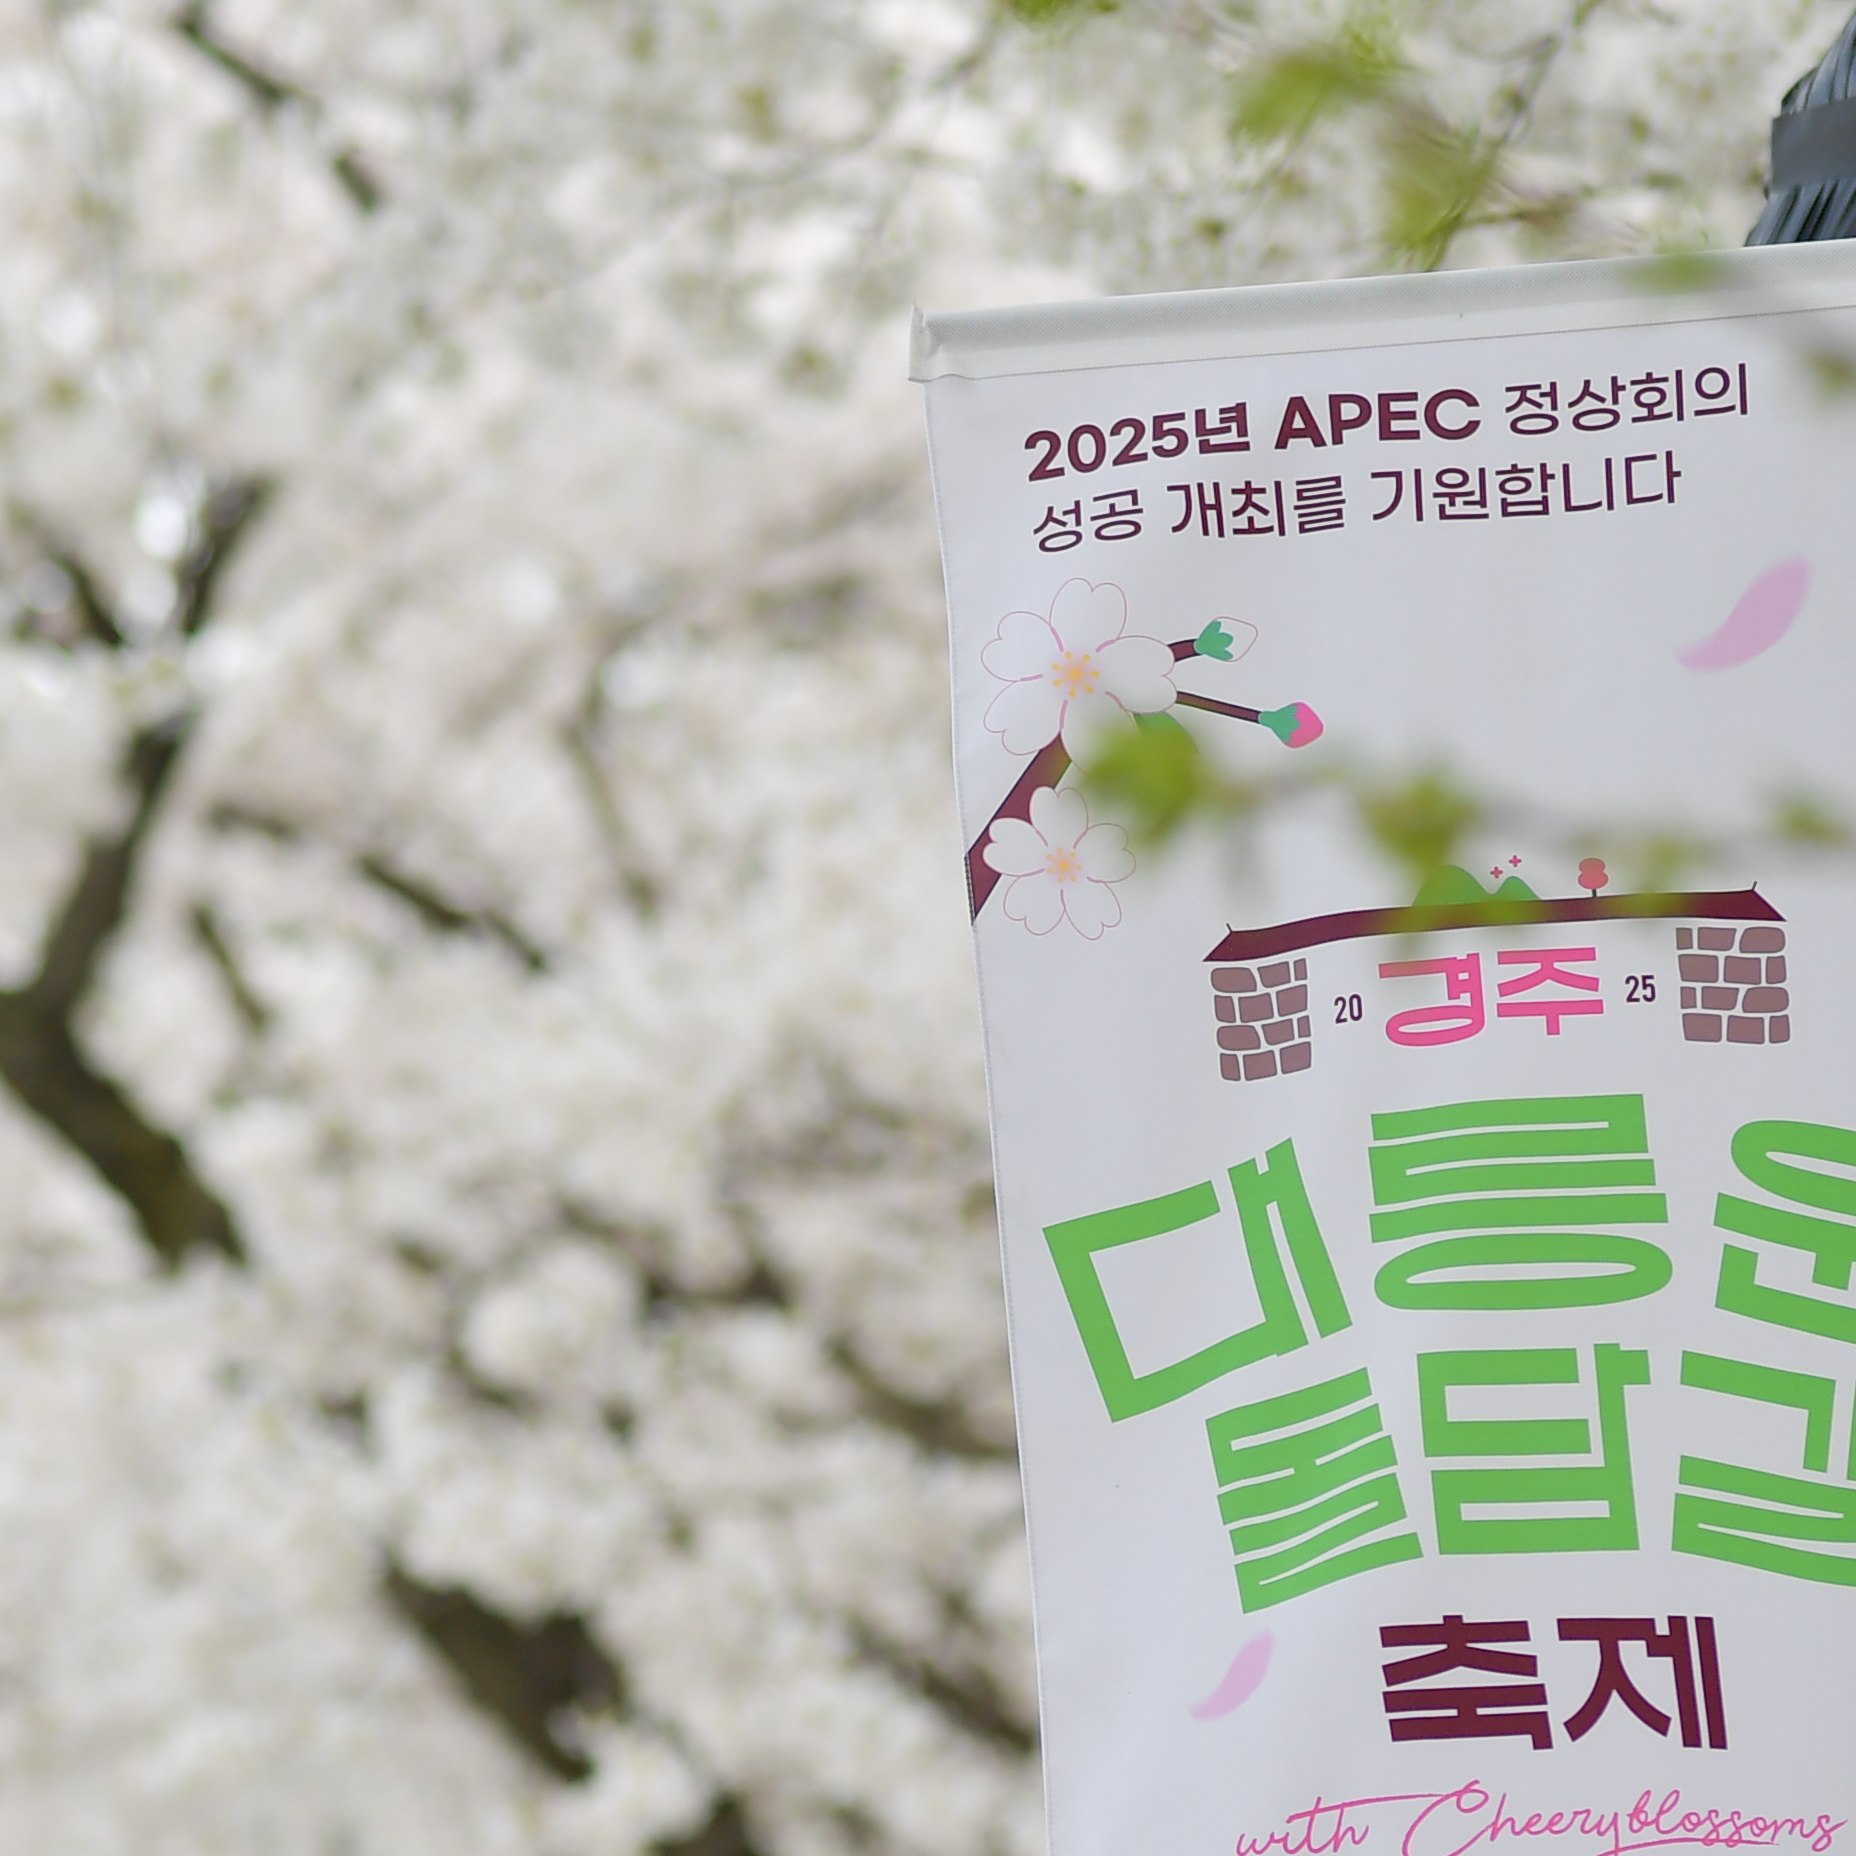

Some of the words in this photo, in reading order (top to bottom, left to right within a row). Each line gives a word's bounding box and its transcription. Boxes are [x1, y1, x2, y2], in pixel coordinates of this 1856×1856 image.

[1024, 402, 1252, 482] 2025년
[1273, 388, 1481, 450] APEC
[1503, 363, 1750, 436] 정상회의
[1032, 489, 1144, 553] 성공
[1167, 474, 1346, 539] 개최를
[1369, 450, 1682, 523] 기원합니다
[1333, 994, 1364, 1024] 20
[1378, 947, 1604, 1047] 경주
[1624, 975, 1657, 1003] 25
[1379, 1614, 1728, 1751] 축제
